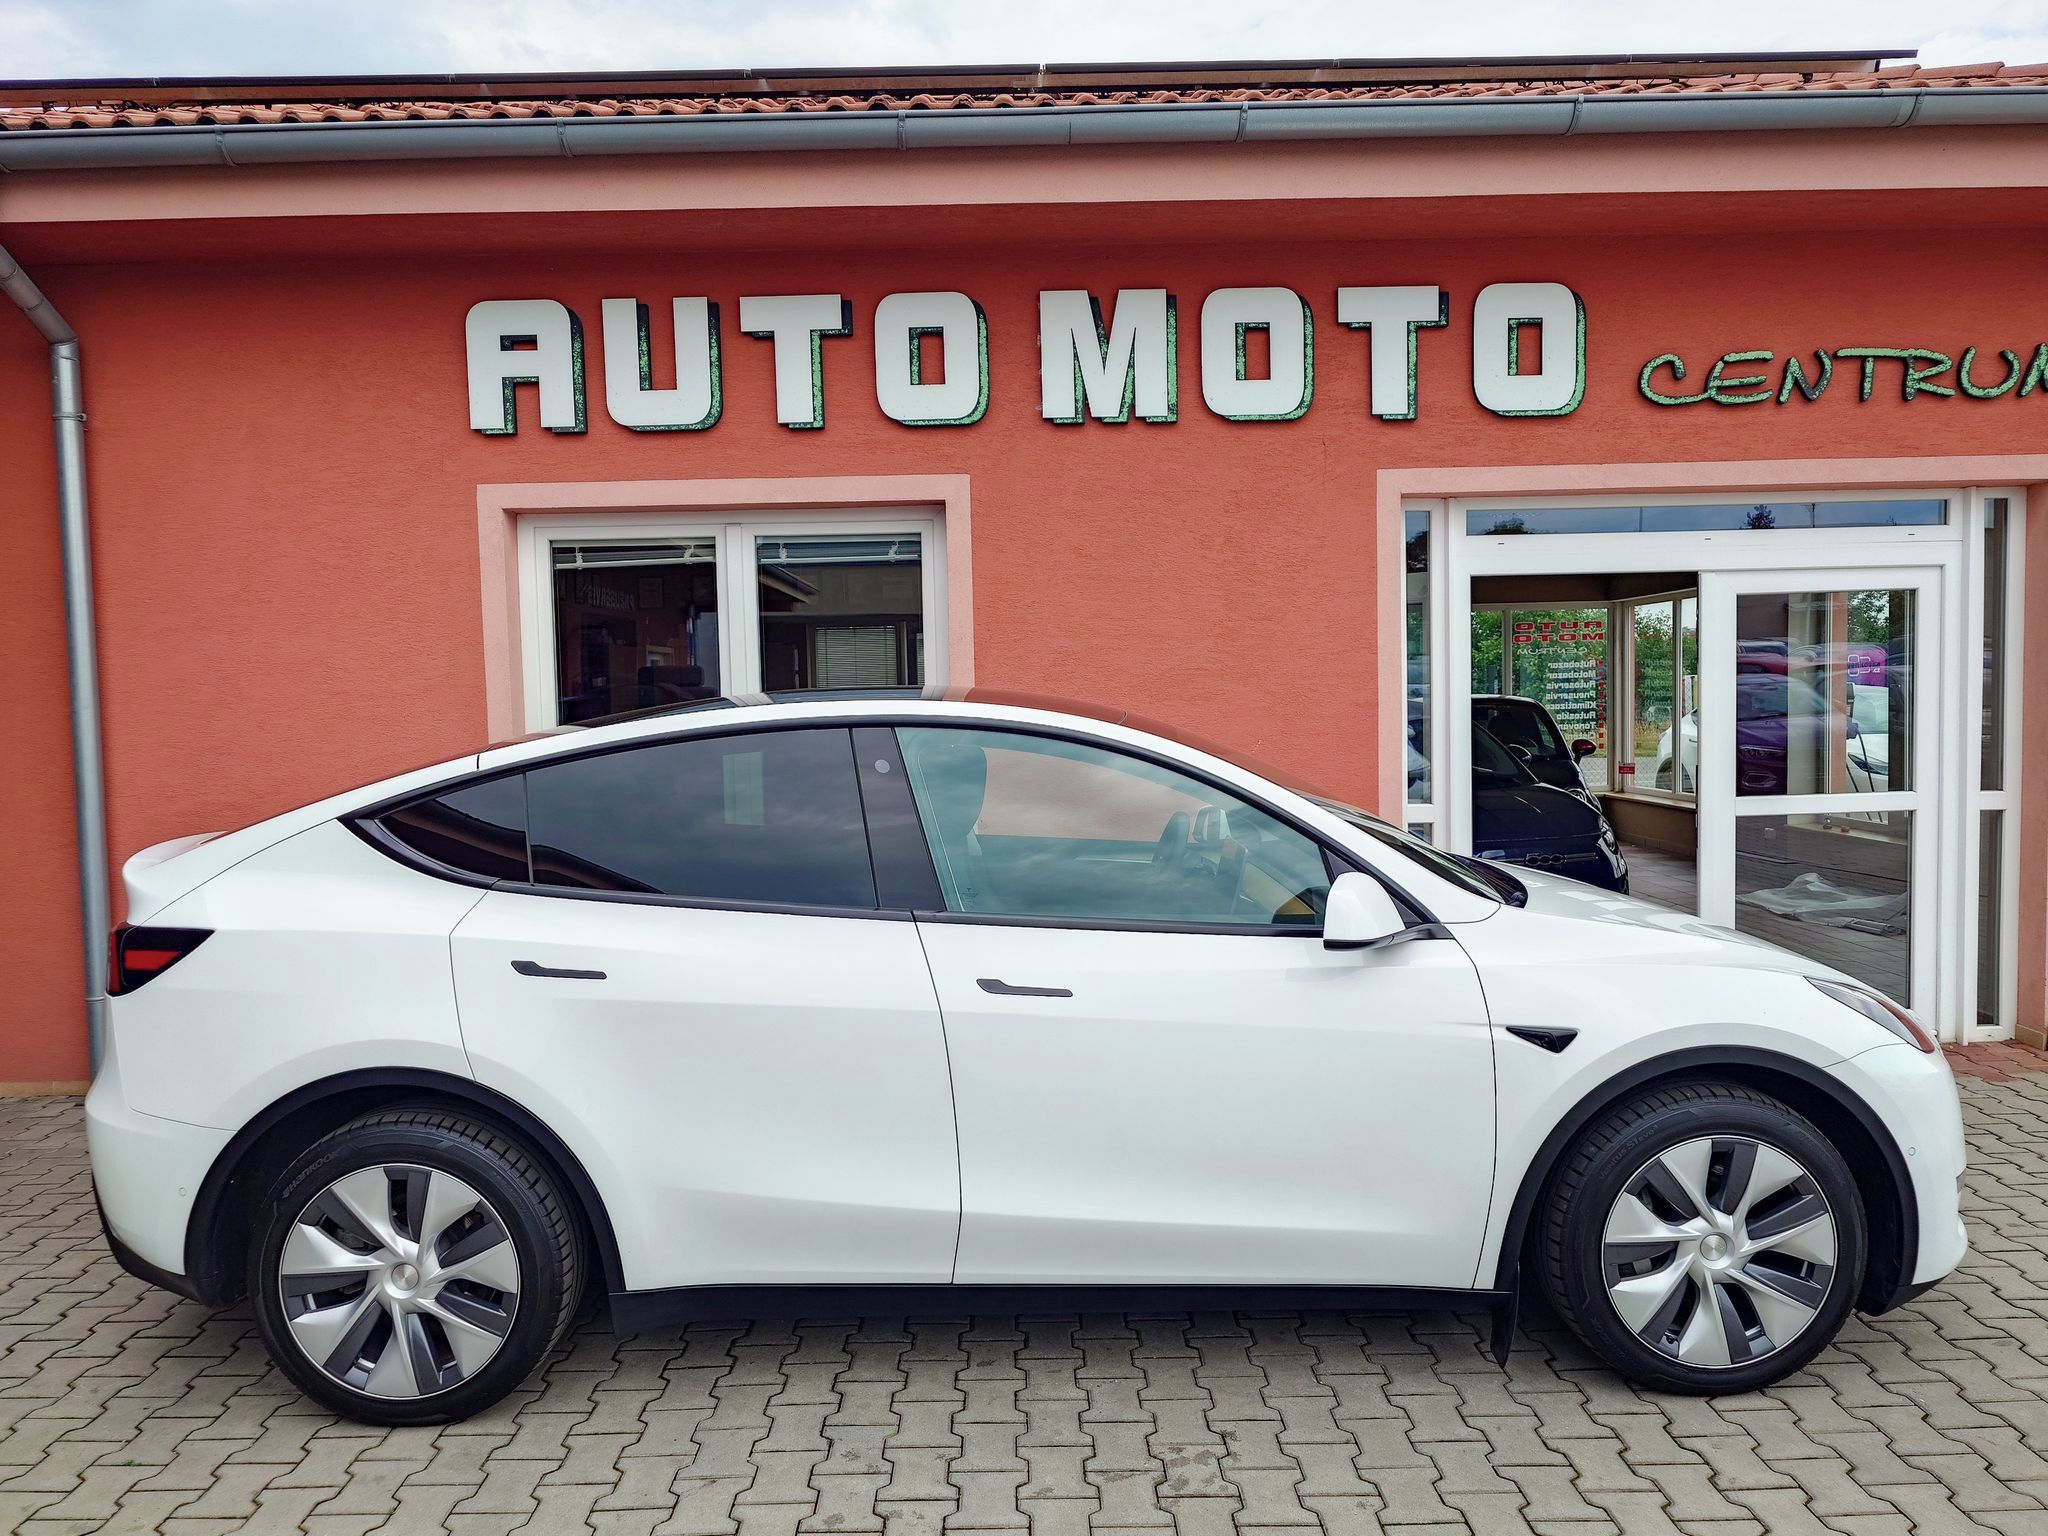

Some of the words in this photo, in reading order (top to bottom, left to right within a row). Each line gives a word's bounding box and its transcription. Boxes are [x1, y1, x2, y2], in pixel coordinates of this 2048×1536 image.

[465, 290, 989, 435] AUTO
[1039, 281, 1587, 424] MOTO
[1525, 852, 1564, 866] 500
